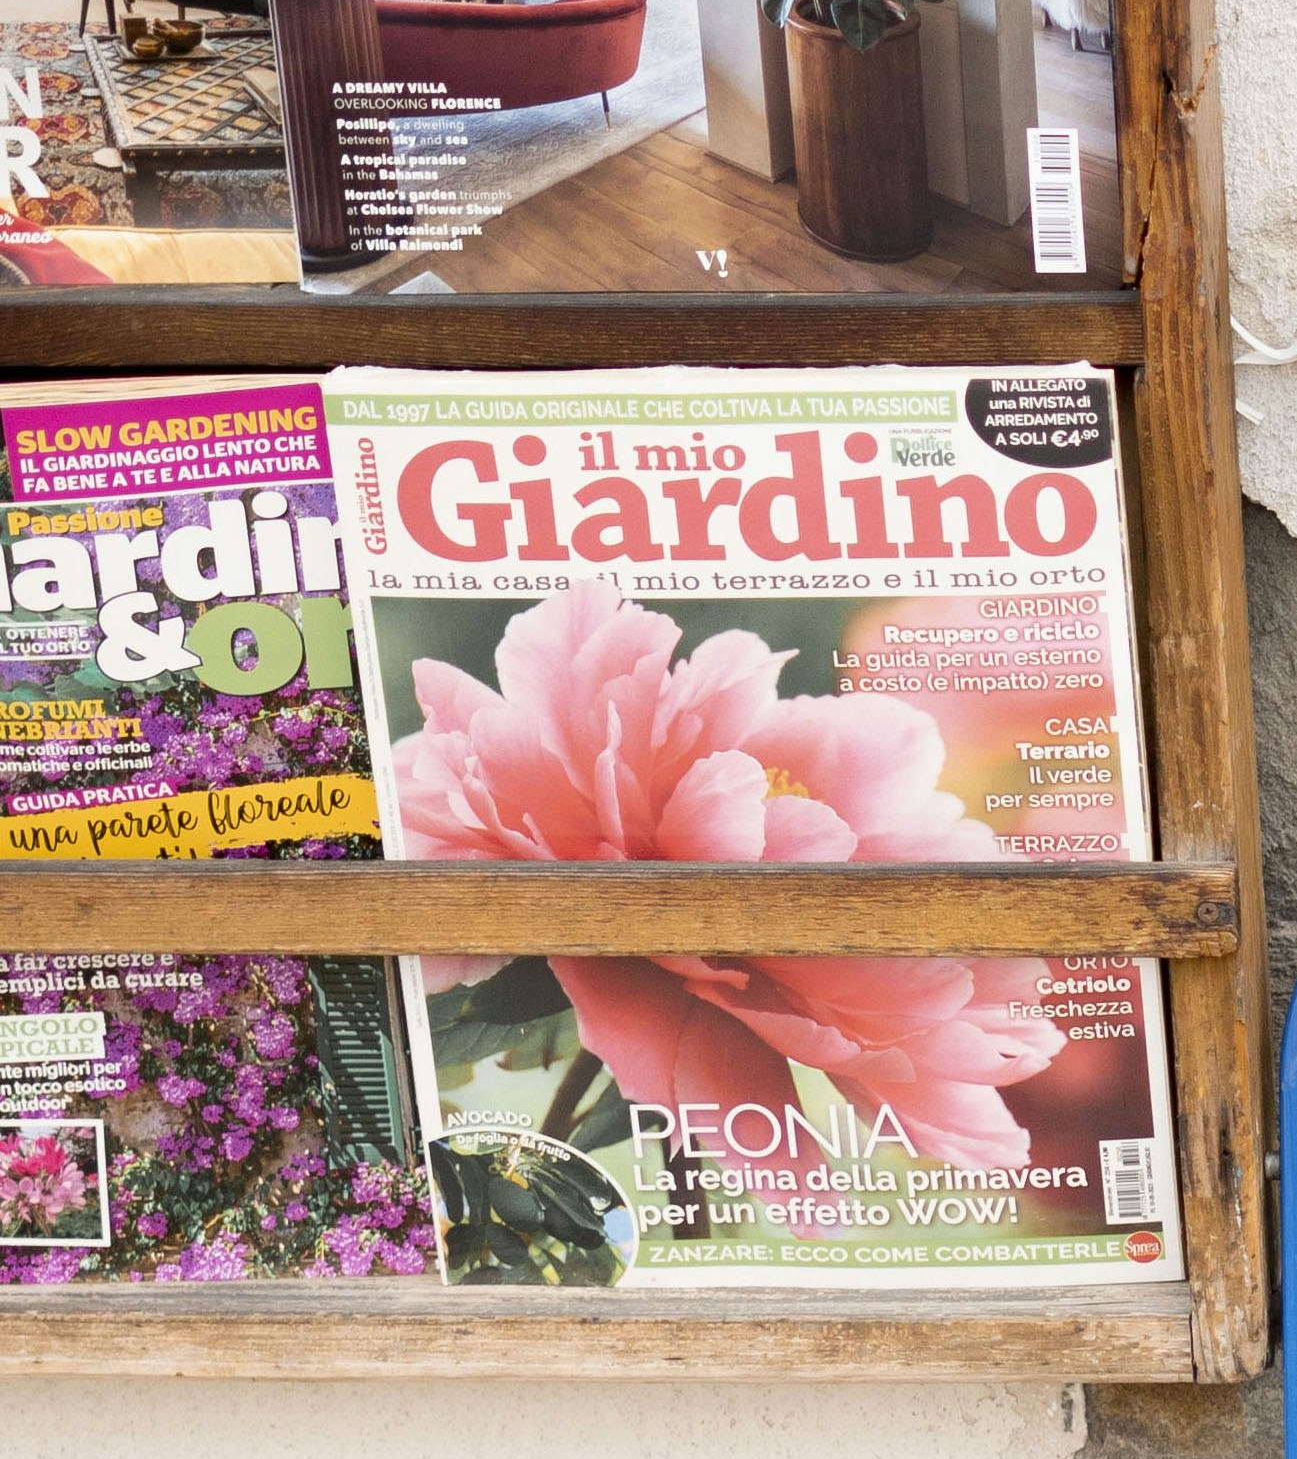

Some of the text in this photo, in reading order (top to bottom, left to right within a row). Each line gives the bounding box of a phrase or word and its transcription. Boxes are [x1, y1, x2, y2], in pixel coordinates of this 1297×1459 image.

[346, 82, 405, 93] DREAMY
[334, 98, 501, 110] OVERLOOKING FLORENCE
[1011, 379, 1087, 392] ALLEGATO
[343, 396, 951, 422] DAL 1997 GUIDA ORIGINALE CHE COLTIVA TUA PASSIONE
[984, 412, 1098, 426] ARREDAMENTO
[16, 407, 317, 455] SLOW GARDENING
[21, 435, 317, 474] IL GIARDINAGGIO LENTO CHE
[579, 431, 746, 472] il mio
[23, 455, 320, 493] FA BENE NATURA
[397, 430, 1097, 562] Giardino
[8, 505, 163, 536] Passione
[412, 572, 482, 590] mia
[980, 597, 1097, 618] GIARDINO
[884, 621, 1099, 646] Recupero riciclo
[866, 647, 1101, 672] guida esterno
[858, 672, 1103, 694] costo impatto) zero
[1045, 718, 1109, 736] CASA
[1016, 741, 1110, 760] Terrario
[1047, 766, 1112, 783] verde
[12, 782, 174, 813] GUIDA PRATICA
[207, 781, 351, 836] floreale
[1029, 790, 1114, 810] sempre
[995, 834, 1118, 853] TERRAZZO
[1036, 975, 1131, 994] Cetriolo
[1009, 1000, 1133, 1018] Freschezza
[1069, 1021, 1135, 1039] estiva
[447, 1110, 532, 1127] AVOCADO
[629, 1104, 919, 1159] PEONIA
[634, 1161, 1088, 1198] La regina della primavera
[639, 1195, 1018, 1231] per un effetto WOW!
[649, 1239, 1121, 1264] ZANZARE: ECCO COME COMBATTERLE
